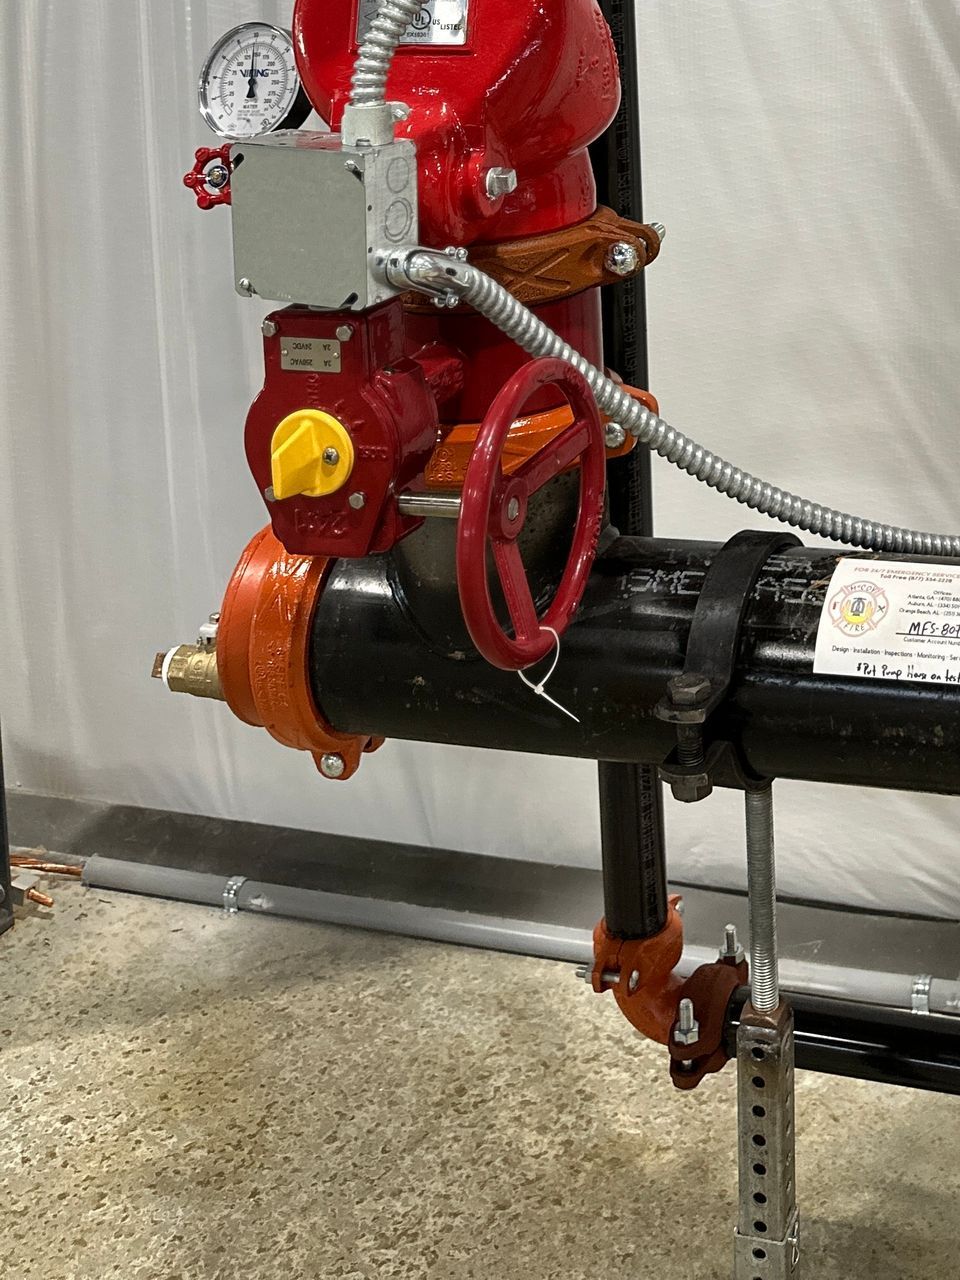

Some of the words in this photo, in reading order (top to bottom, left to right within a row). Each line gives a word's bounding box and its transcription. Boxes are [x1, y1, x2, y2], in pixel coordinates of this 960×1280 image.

[832, 645, 849, 653] Design
[853, 647, 881, 655] Installation
[884, 649, 913, 658] Inspections
[917, 652, 946, 661] Monitoring
[882, 664, 902, 680] Pump
